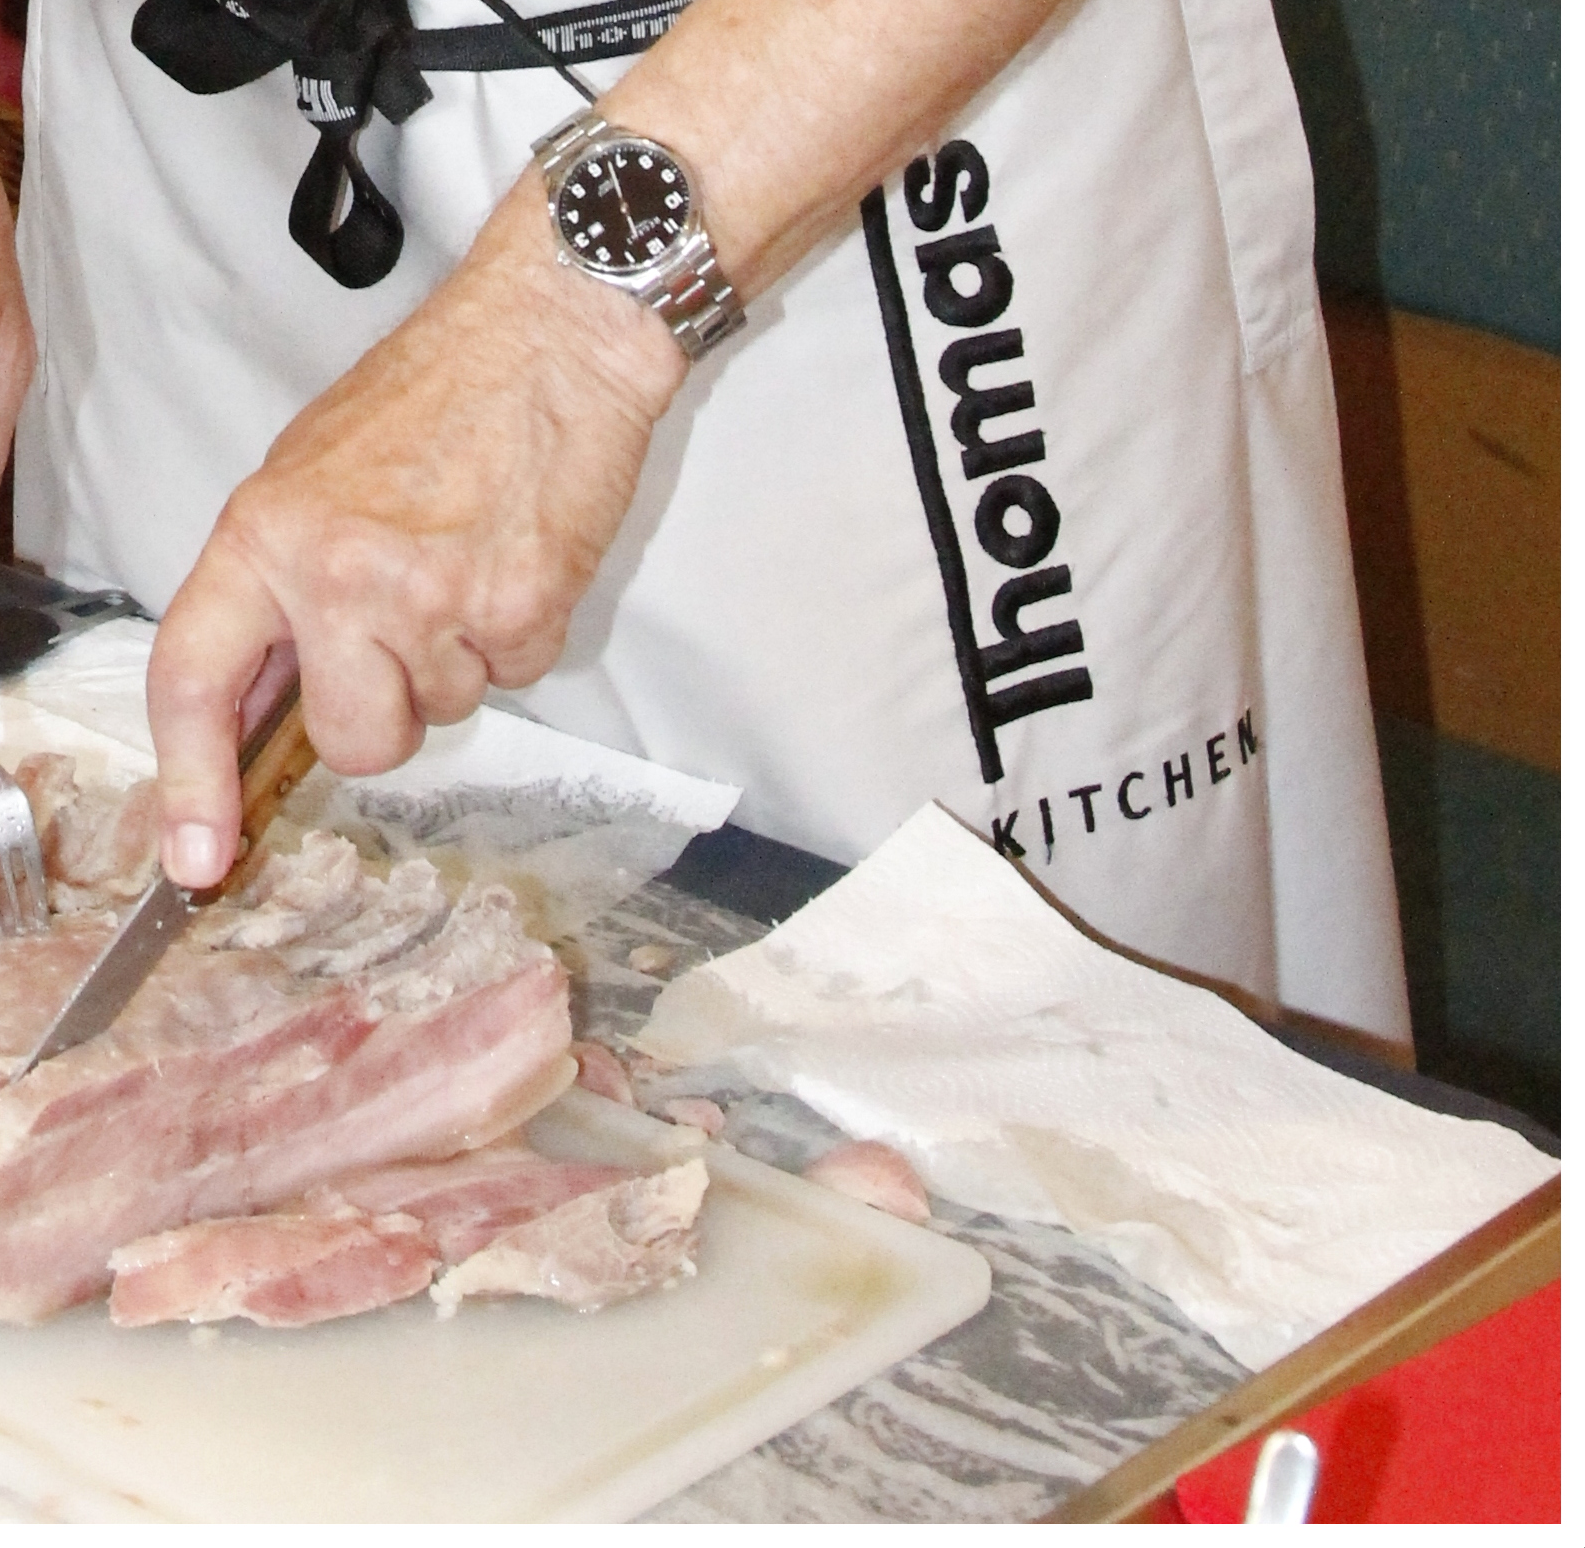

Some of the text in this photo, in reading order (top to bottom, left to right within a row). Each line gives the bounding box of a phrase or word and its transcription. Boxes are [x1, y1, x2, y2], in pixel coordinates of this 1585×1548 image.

[615, 154, 627, 169] 7
[664, 191, 684, 210] 10
[567, 209, 579, 224] 4
[574, 232, 590, 248] 3
[860, 138, 1094, 784] Thomas
[991, 706, 1258, 859] KITCHEN
